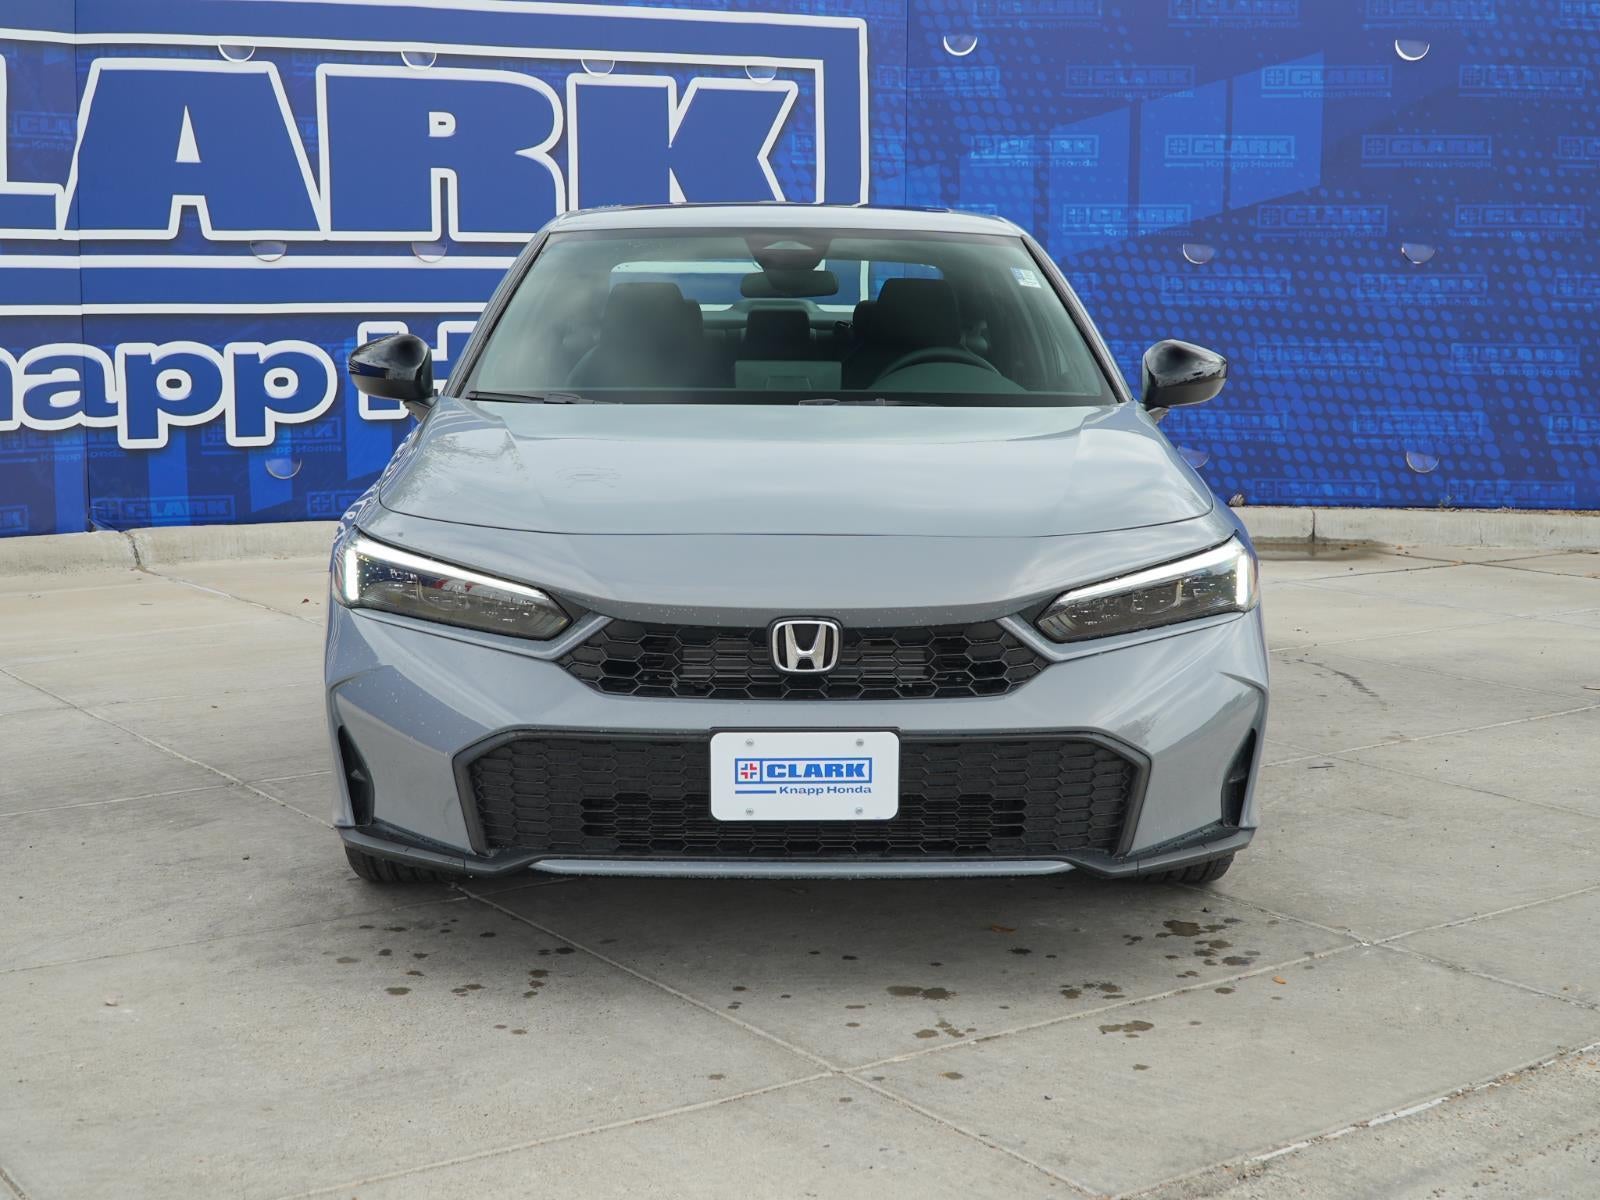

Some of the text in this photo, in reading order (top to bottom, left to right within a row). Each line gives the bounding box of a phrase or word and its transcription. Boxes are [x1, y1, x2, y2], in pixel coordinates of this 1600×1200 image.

[766, 763, 865, 778] CLARK
[779, 785, 872, 796] Knapp Honda
